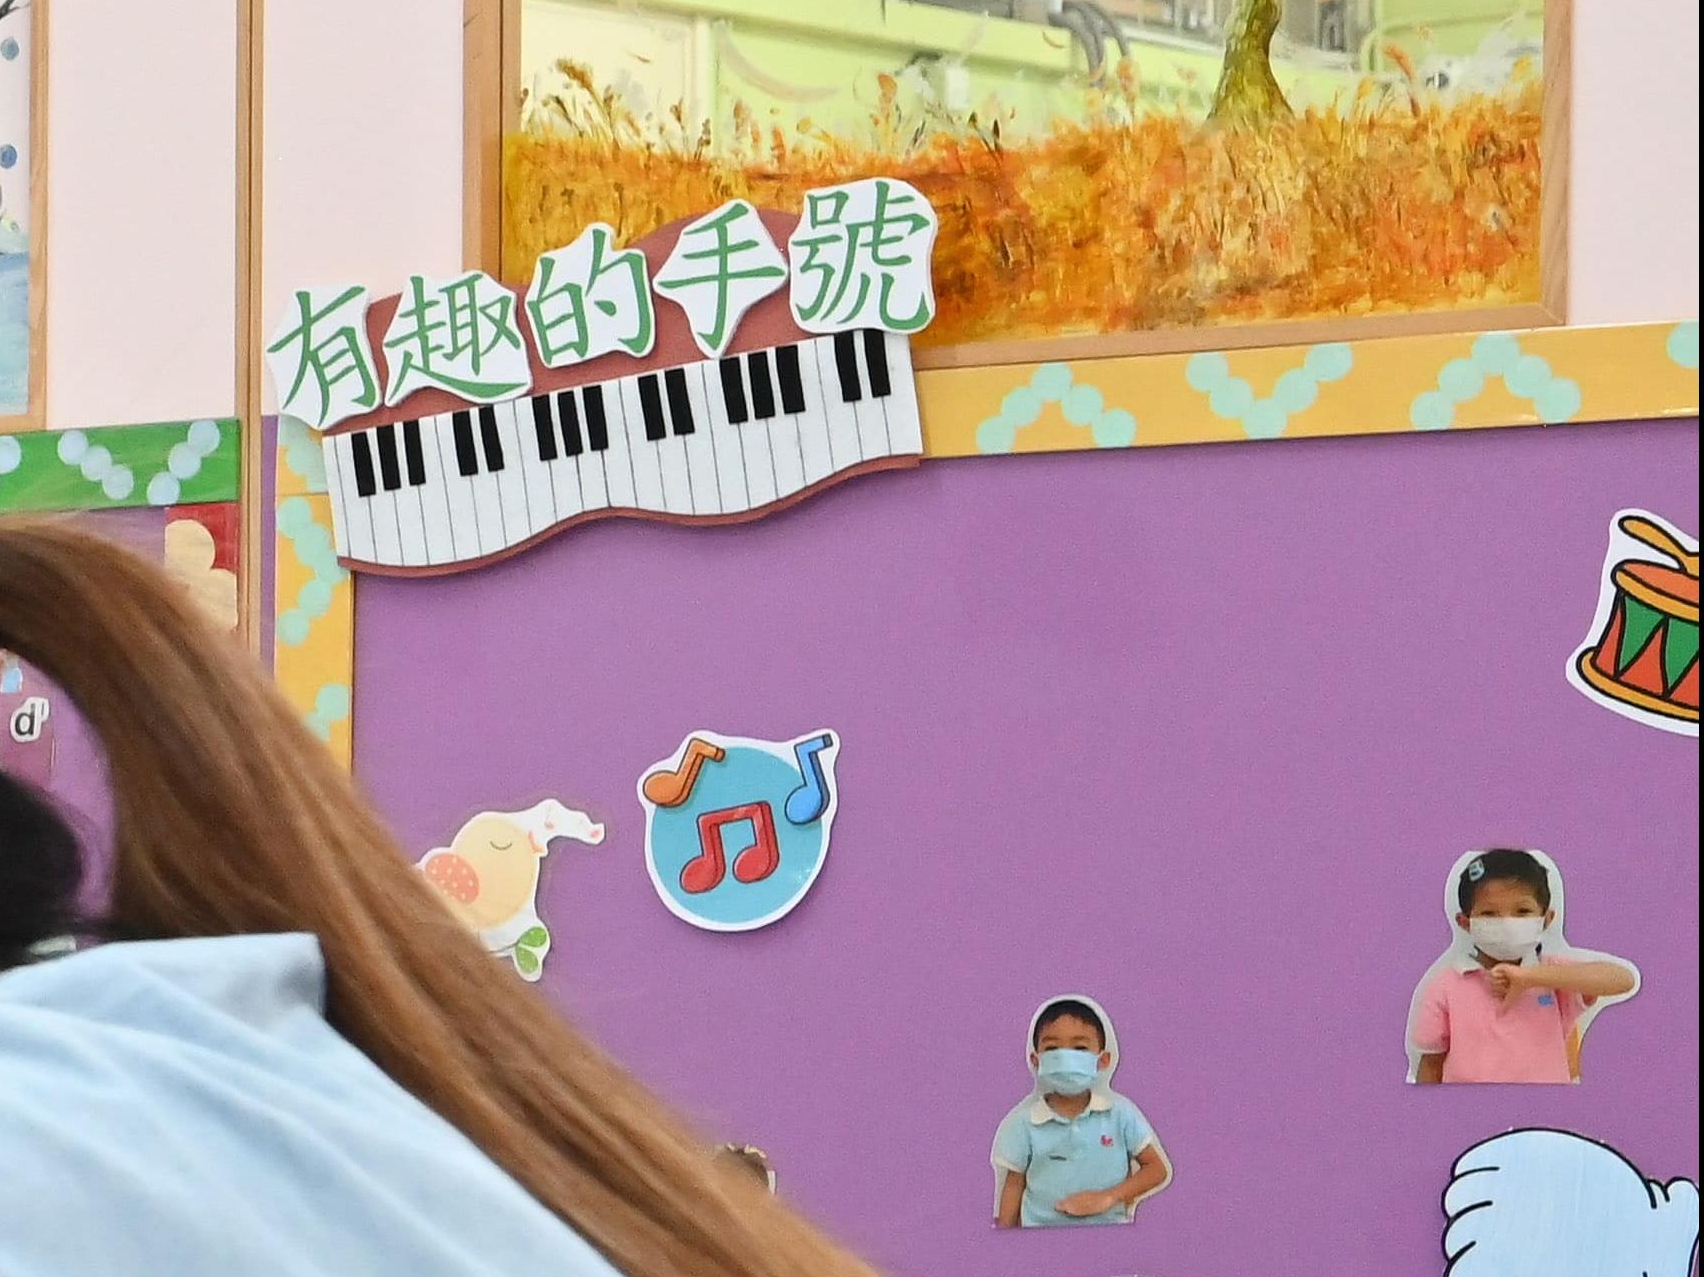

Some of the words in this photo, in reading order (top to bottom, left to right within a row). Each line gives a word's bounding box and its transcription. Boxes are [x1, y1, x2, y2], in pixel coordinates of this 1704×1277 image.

[268, 181, 931, 424] 有趣的手號
